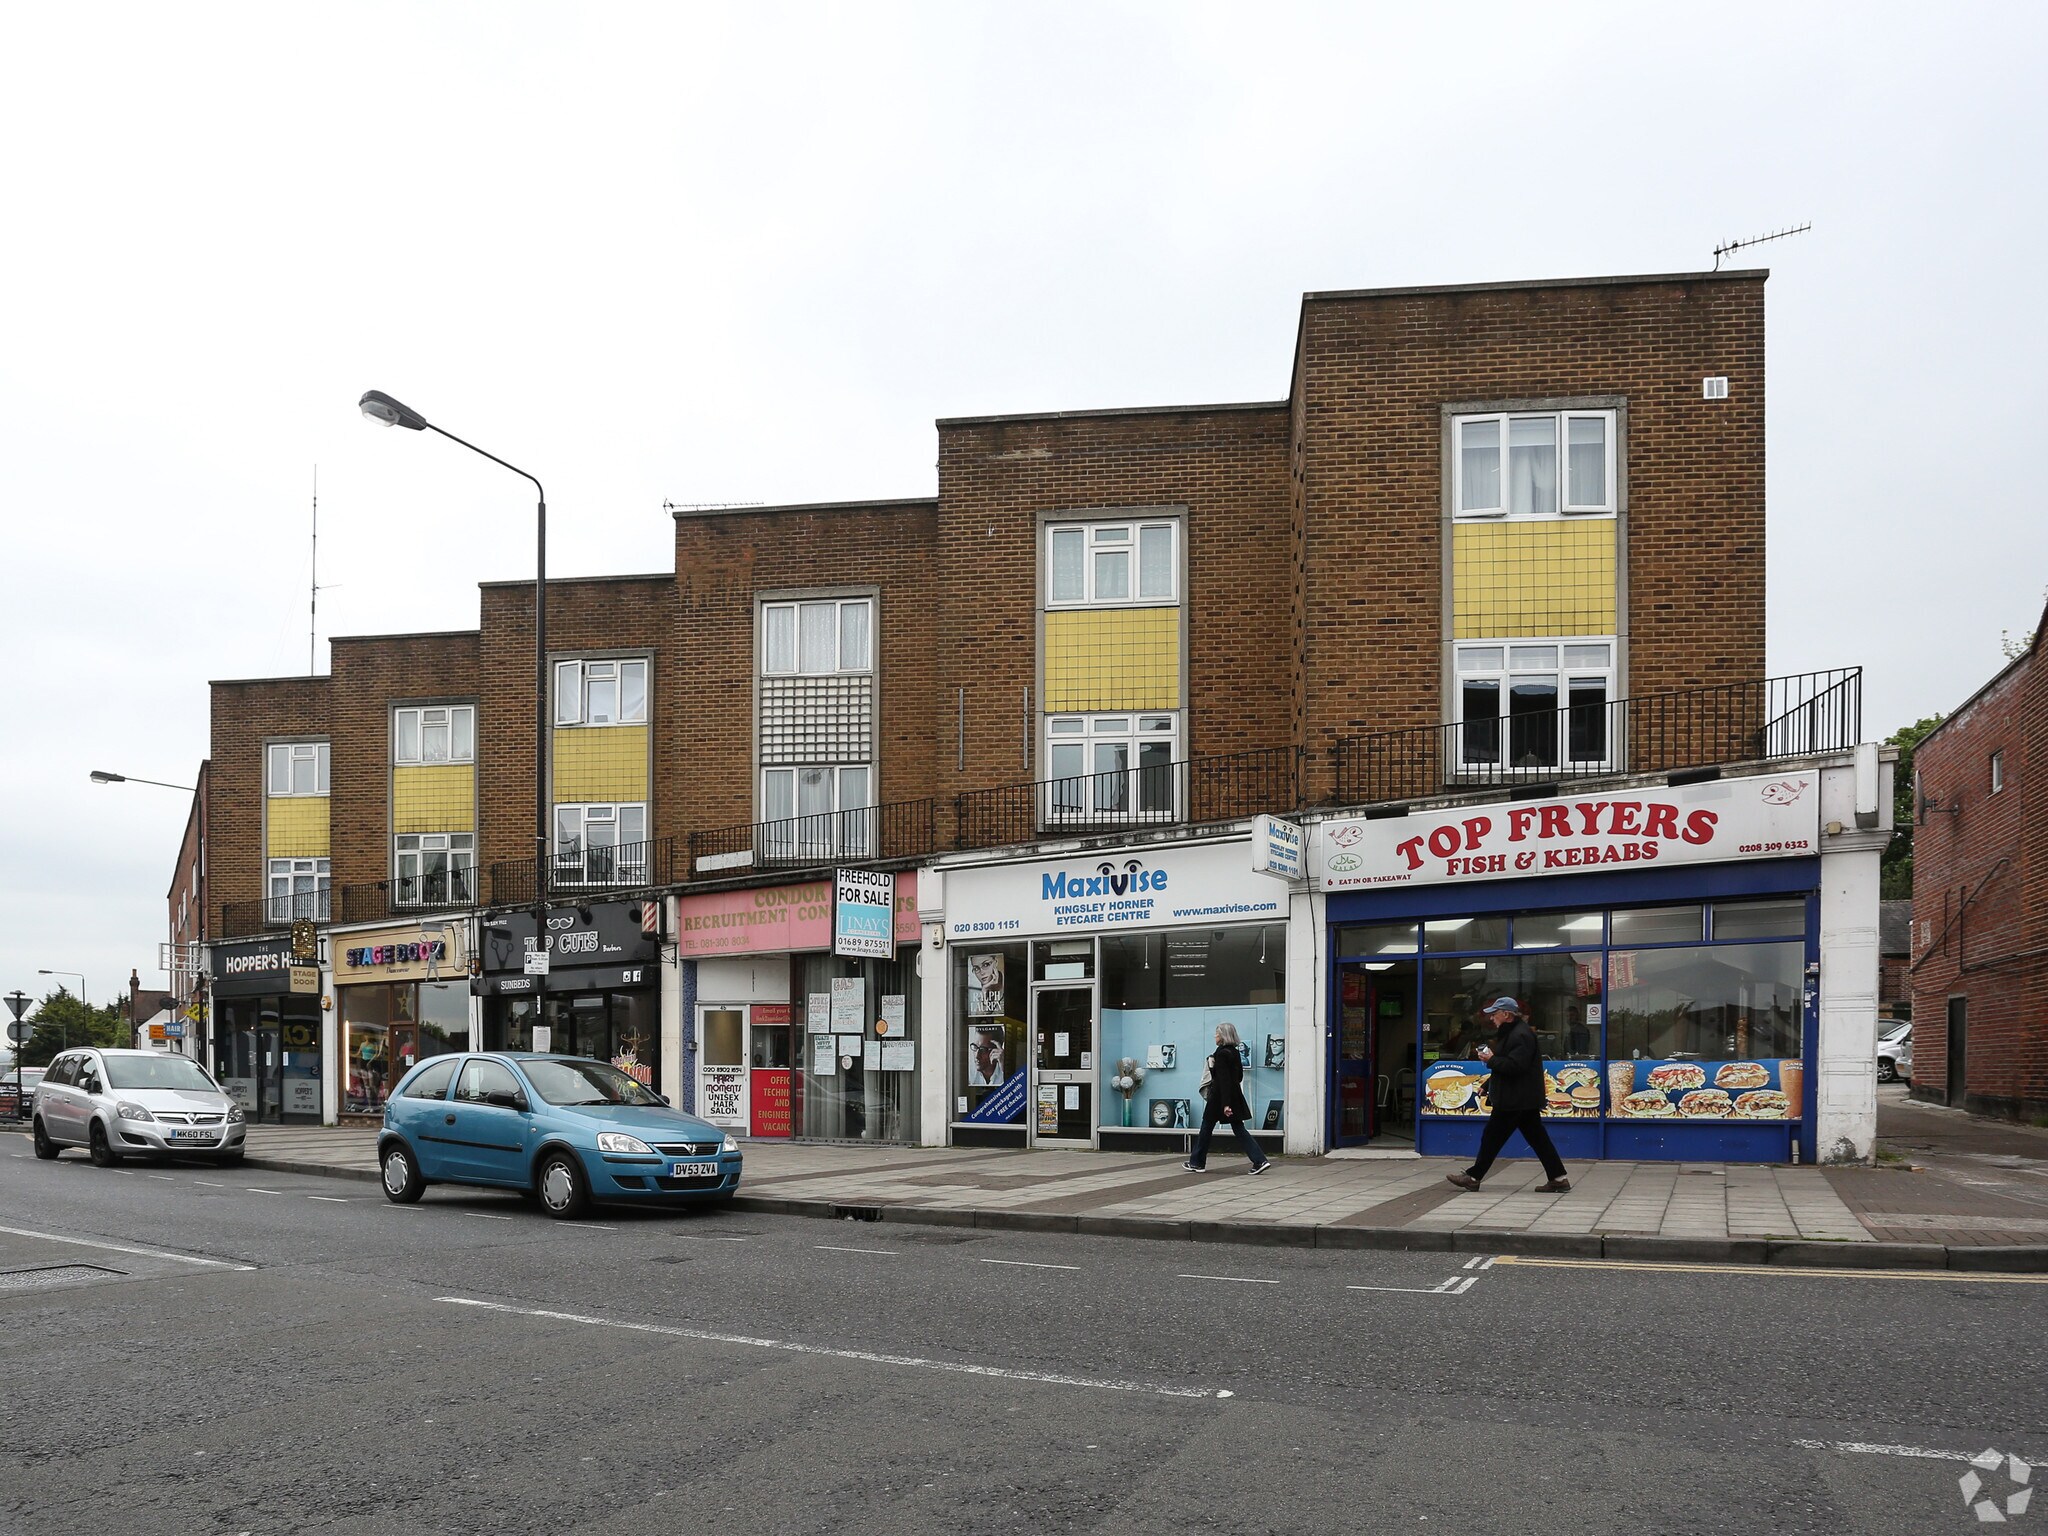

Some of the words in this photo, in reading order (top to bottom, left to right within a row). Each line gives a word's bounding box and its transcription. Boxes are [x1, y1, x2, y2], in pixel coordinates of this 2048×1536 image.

[1269, 822, 1299, 846] Maxivise
[1396, 816, 1492, 870] TOP
[1507, 801, 1718, 845] FRYERS
[1739, 844, 1762, 853] 0208
[1764, 842, 1784, 852] 309
[1784, 840, 1808, 850] 6323
[1446, 855, 1506, 876] FISH
[1514, 851, 1536, 870] &
[1544, 841, 1659, 868] KEBABS
[1332, 863, 1359, 872] HALAL
[839, 869, 891, 888] FREEHOLD
[1042, 862, 1168, 901] Maxivise
[1338, 878, 1352, 886] EAT
[1373, 874, 1412, 883] TAKEAWAY
[754, 885, 827, 908] CONDOR
[839, 886, 862, 904] FOR
[863, 890, 890, 906] SALE
[1054, 902, 1106, 914] KINGSLEY
[1109, 898, 1154, 910] HORNER
[1172, 901, 1277, 918] www.maxivise.com
[684, 908, 788, 931] RECRUITMENT
[797, 904, 832, 922] CON
[1056, 914, 1104, 926] EYECARE
[1107, 910, 1151, 922] CENTRE
[839, 914, 890, 938] LINAYS
[954, 923, 971, 933] 020
[972, 921, 996, 932] 8300
[997, 920, 1020, 931] 1151
[558, 930, 599, 954] CUTS
[685, 939, 698, 949] TEL:
[700, 938, 729, 948] 081-300
[838, 937, 862, 946] 01689
[864, 939, 890, 948] 875511
[345, 944, 396, 967] STAGE
[396, 940, 446, 962] DOOR
[602, 944, 622, 953] Barbers
[225, 954, 279, 974] HOPPER'S
[281, 951, 292, 969] H
[293, 970, 317, 978] STAGE
[293, 978, 315, 986] DOOR
[500, 978, 531, 990] SUNBEDS
[972, 990, 1001, 1002] RALPH
[970, 1000, 1003, 1012] LAUREN
[770, 1076, 790, 1085] OFFIC
[705, 1084, 742, 1093] MOMENTS
[763, 1087, 790, 1097] TECHNI
[971, 1091, 1002, 1119] Comprehensive
[1014, 1071, 1025, 1081] lens
[774, 1099, 790, 1107] AND
[710, 1107, 738, 1115] SALON
[758, 1110, 791, 1119] ENGINEE
[985, 1107, 995, 1117] care
[997, 1104, 1009, 1116] FREE
[763, 1122, 791, 1131] VACANC
[176, 1130, 198, 1139] MK60
[200, 1130, 215, 1139] FSL
[675, 1164, 700, 1175] DV53
[701, 1163, 717, 1174] ZVA
